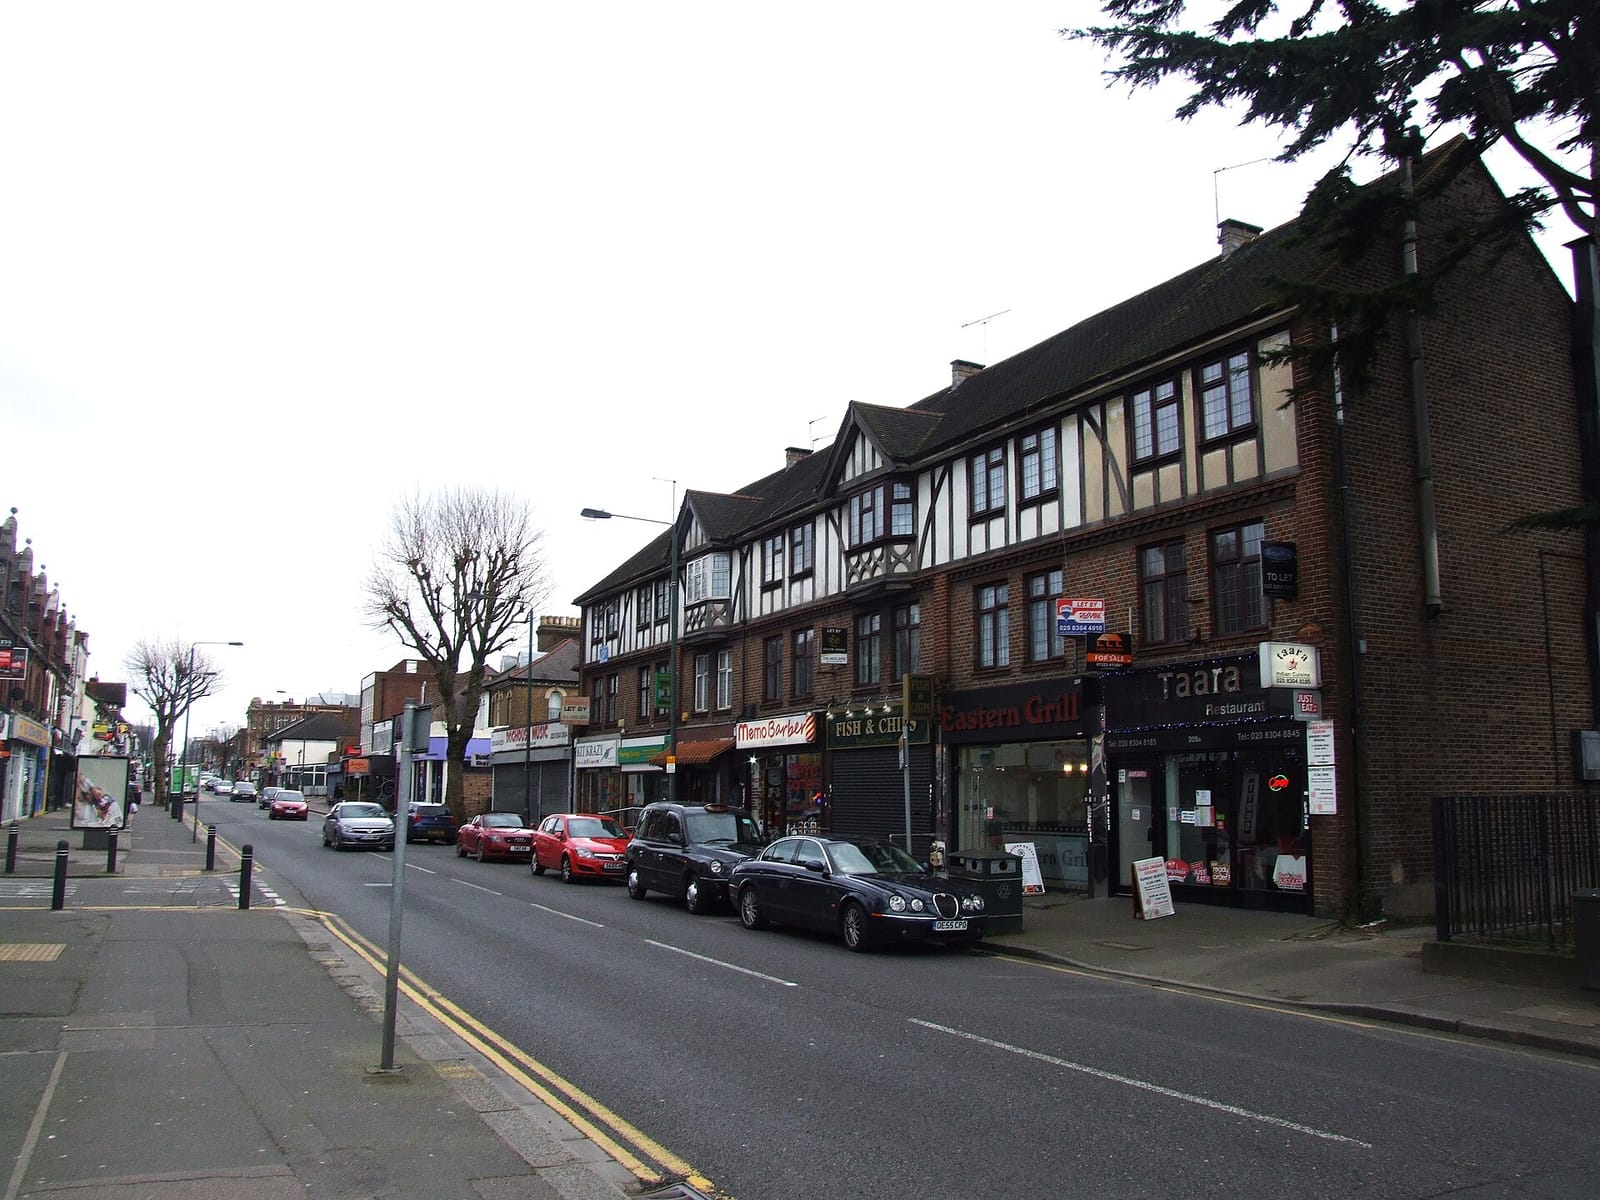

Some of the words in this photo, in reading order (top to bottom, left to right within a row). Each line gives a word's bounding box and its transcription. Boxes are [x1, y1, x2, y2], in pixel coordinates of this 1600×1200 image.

[1266, 572, 1278, 581] TO
[1279, 573, 1293, 582] LET
[1094, 654, 1107, 662] FOR
[1107, 654, 1124, 662] SALE
[1277, 647, 1308, 662] taara
[1157, 665, 1241, 700] Taara
[1297, 693, 1313, 703] JUST
[941, 704, 1021, 732] Eastern
[1025, 692, 1079, 725] Grill
[1205, 700, 1265, 717] Restaurant
[532, 724, 548, 740] MUSIC
[738, 723, 767, 742] Memo
[767, 720, 806, 738] Barber
[835, 720, 862, 737] FISH
[865, 719, 875, 735] &
[878, 716, 917, 734] CHIS
[1250, 731, 1263, 740] 020
[1264, 730, 1281, 739] 8304
